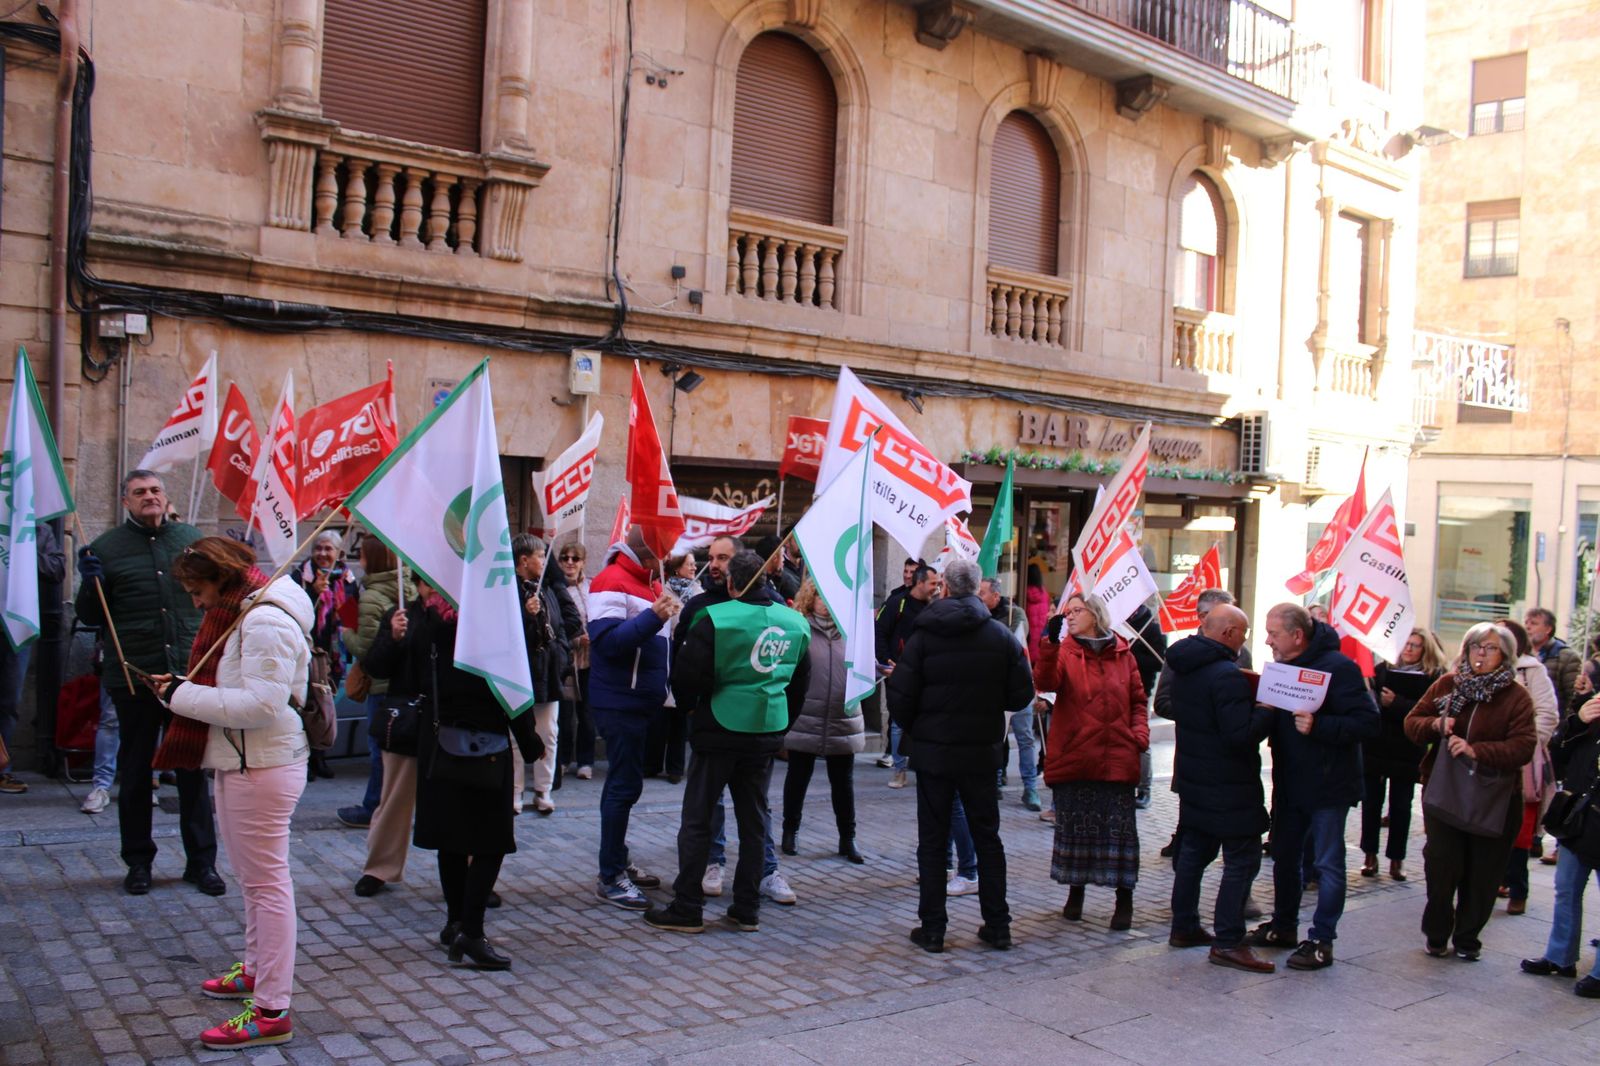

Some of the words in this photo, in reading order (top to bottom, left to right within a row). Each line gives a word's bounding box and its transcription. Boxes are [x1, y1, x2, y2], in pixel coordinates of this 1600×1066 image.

[1018, 410, 1090, 449] BAR
[550, 452, 597, 507] CCO
[272, 502, 294, 539] León
[896, 500, 909, 515] y
[760, 640, 791, 657] CSIF
